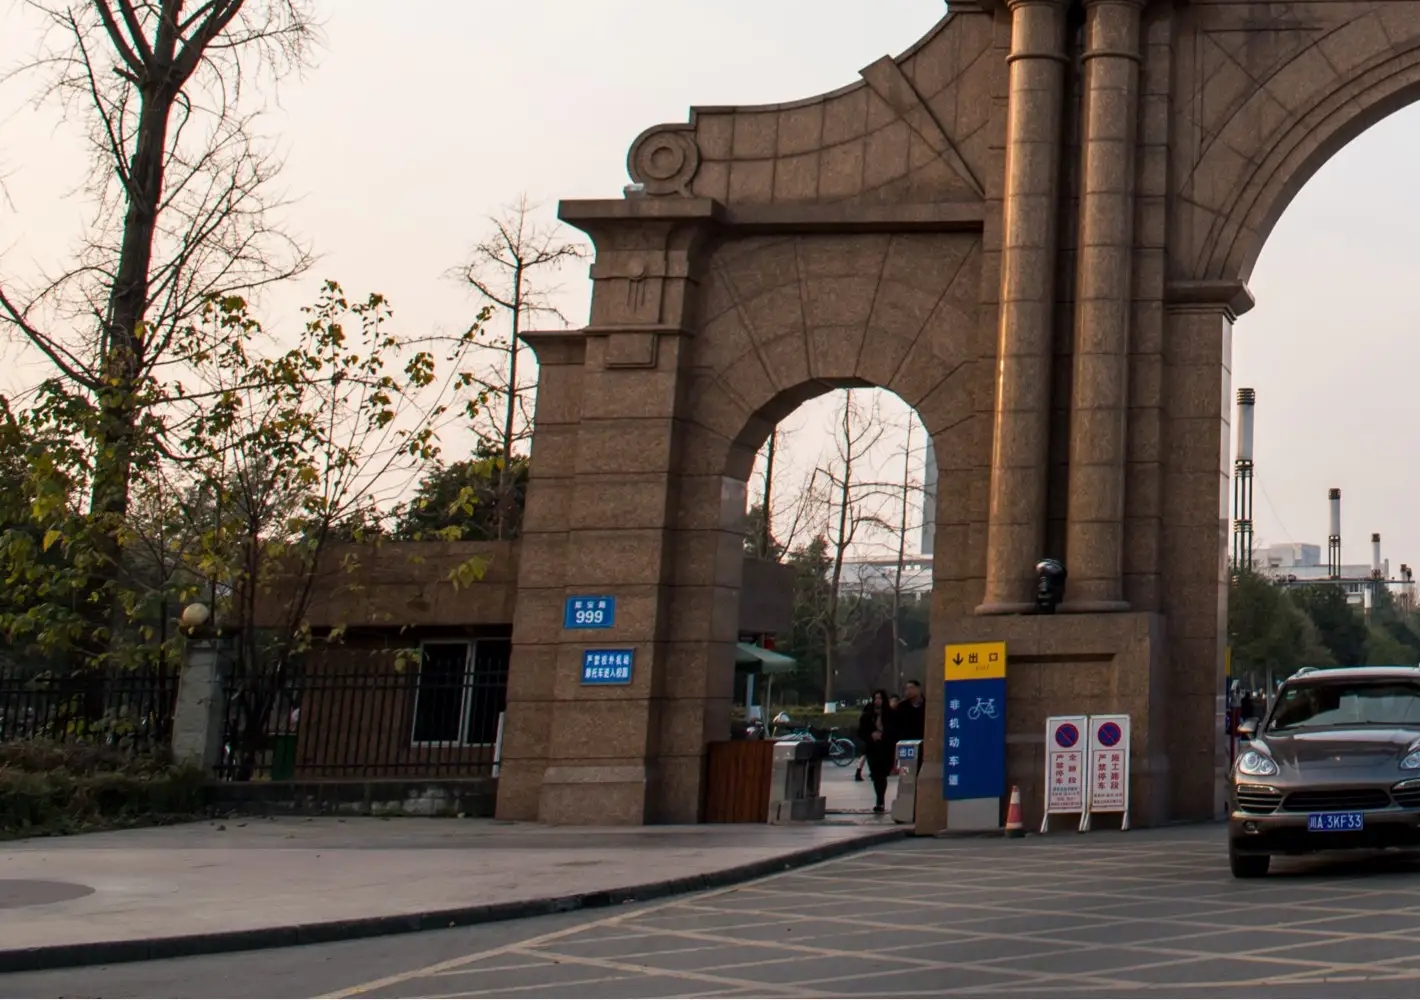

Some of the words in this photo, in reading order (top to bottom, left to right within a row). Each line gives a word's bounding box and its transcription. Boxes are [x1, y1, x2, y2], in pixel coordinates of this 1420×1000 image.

[575, 610, 604, 624] 999
[968, 652, 998, 664] 出口
[899, 748, 914, 757] 出口
[948, 699, 960, 786] 非机动车道
[1056, 754, 1065, 785] 严禁停车
[1097, 754, 1106, 790] 严禁停车
[1110, 753, 1120, 789] 施工路段
